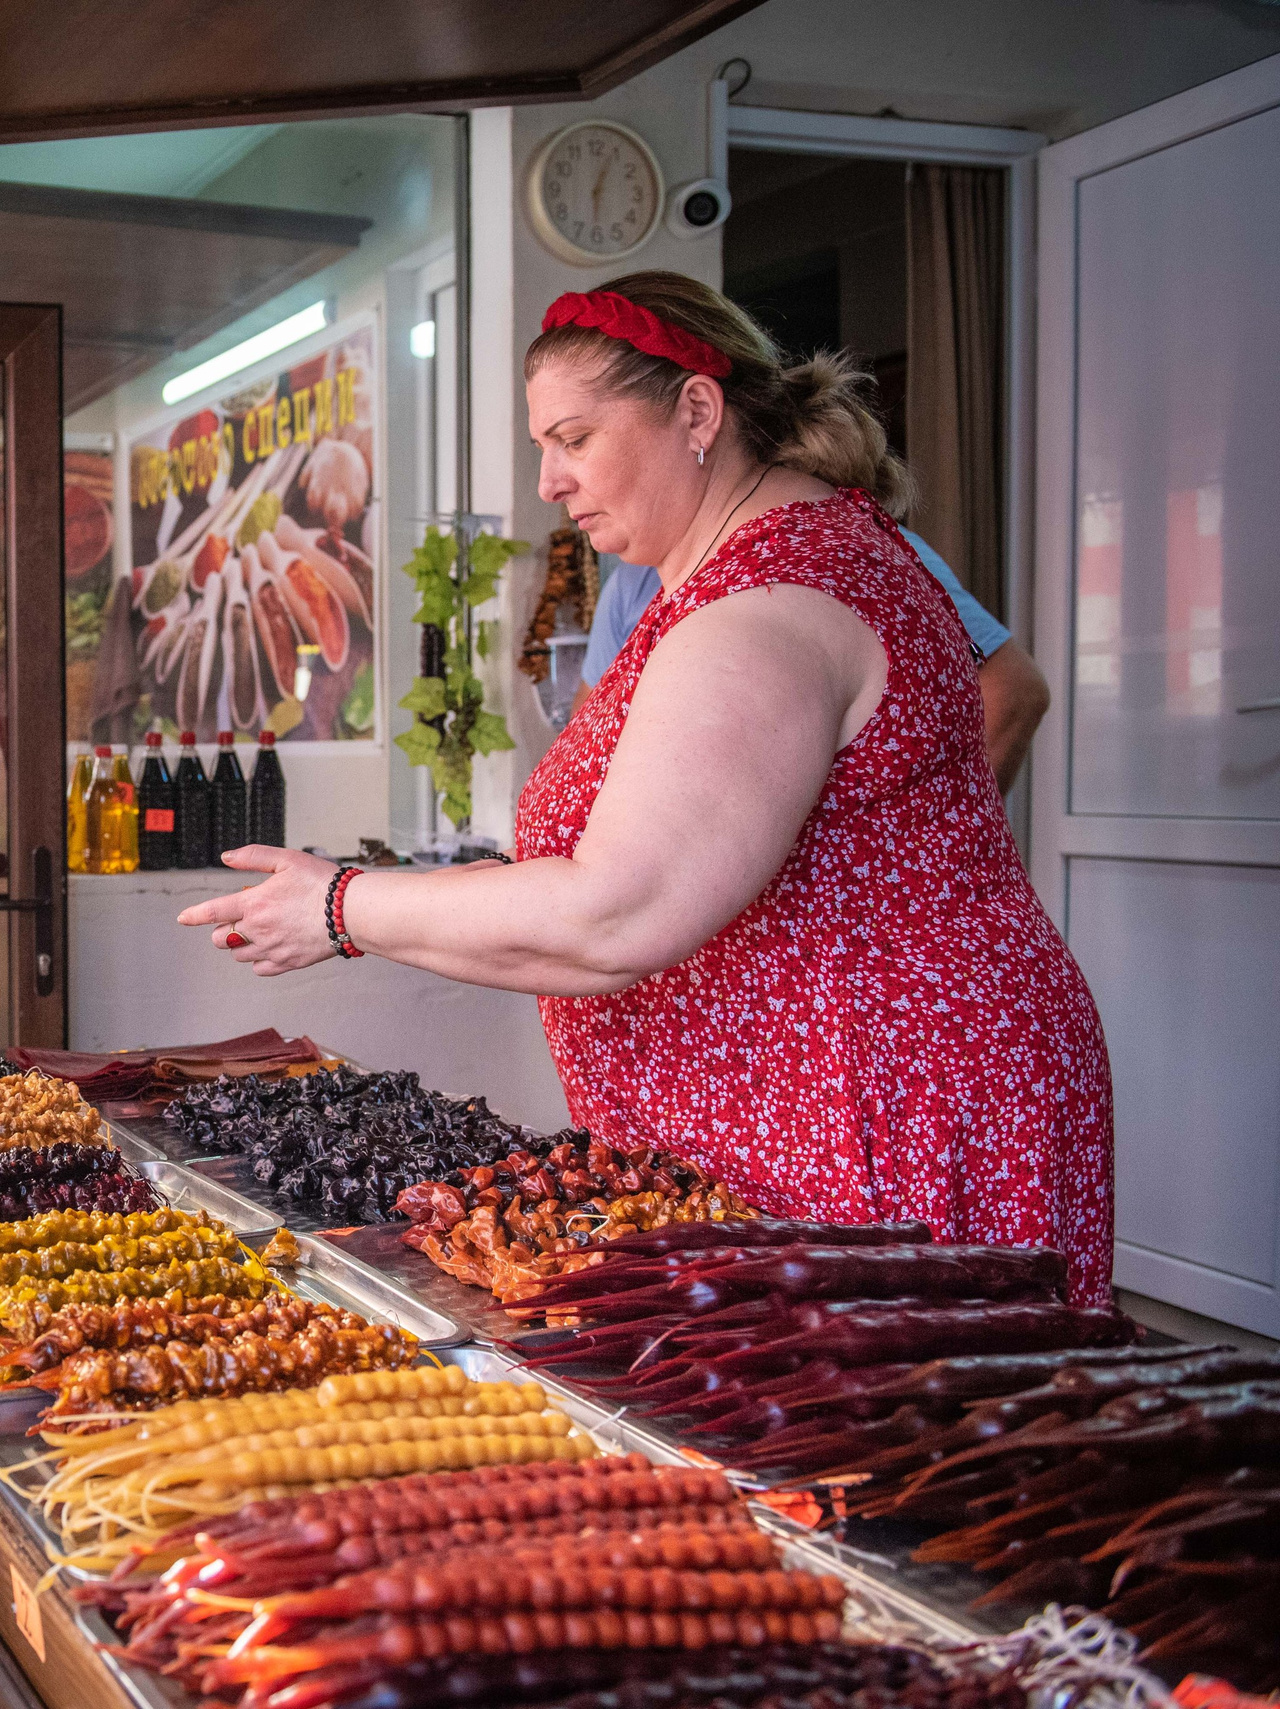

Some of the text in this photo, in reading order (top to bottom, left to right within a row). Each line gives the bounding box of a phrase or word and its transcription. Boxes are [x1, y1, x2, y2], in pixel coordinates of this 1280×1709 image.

[587, 139, 605, 157] 12
[624, 162, 636, 179] 2
[632, 184, 643, 203] 3
[624, 207, 637, 224] 4
[574, 221, 585, 239] 7
[591, 225, 604, 244] 6
[611, 222, 623, 241] 5
